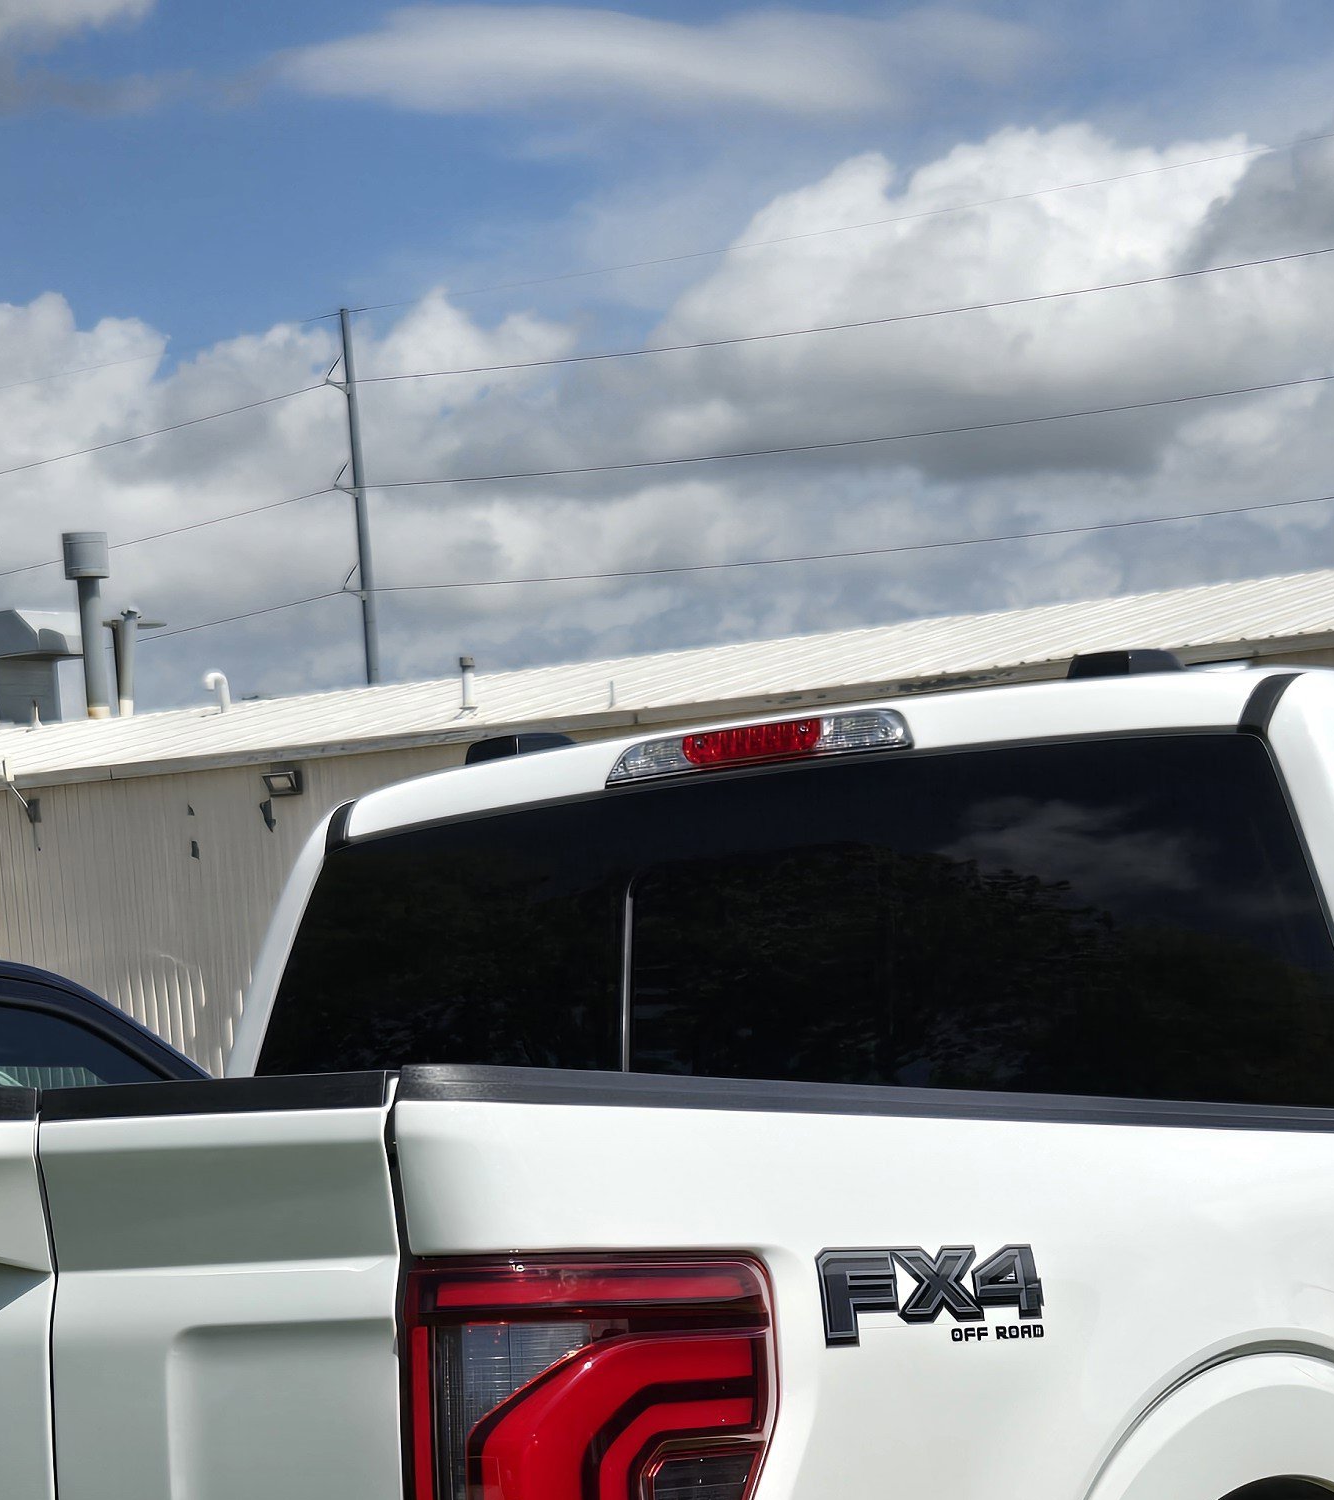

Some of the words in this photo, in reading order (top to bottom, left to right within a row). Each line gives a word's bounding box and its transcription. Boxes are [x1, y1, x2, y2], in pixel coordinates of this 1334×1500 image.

[815, 1244, 1044, 1349] FX4
[951, 1325, 988, 1342] OFF
[996, 1323, 1045, 1341] ROAD
